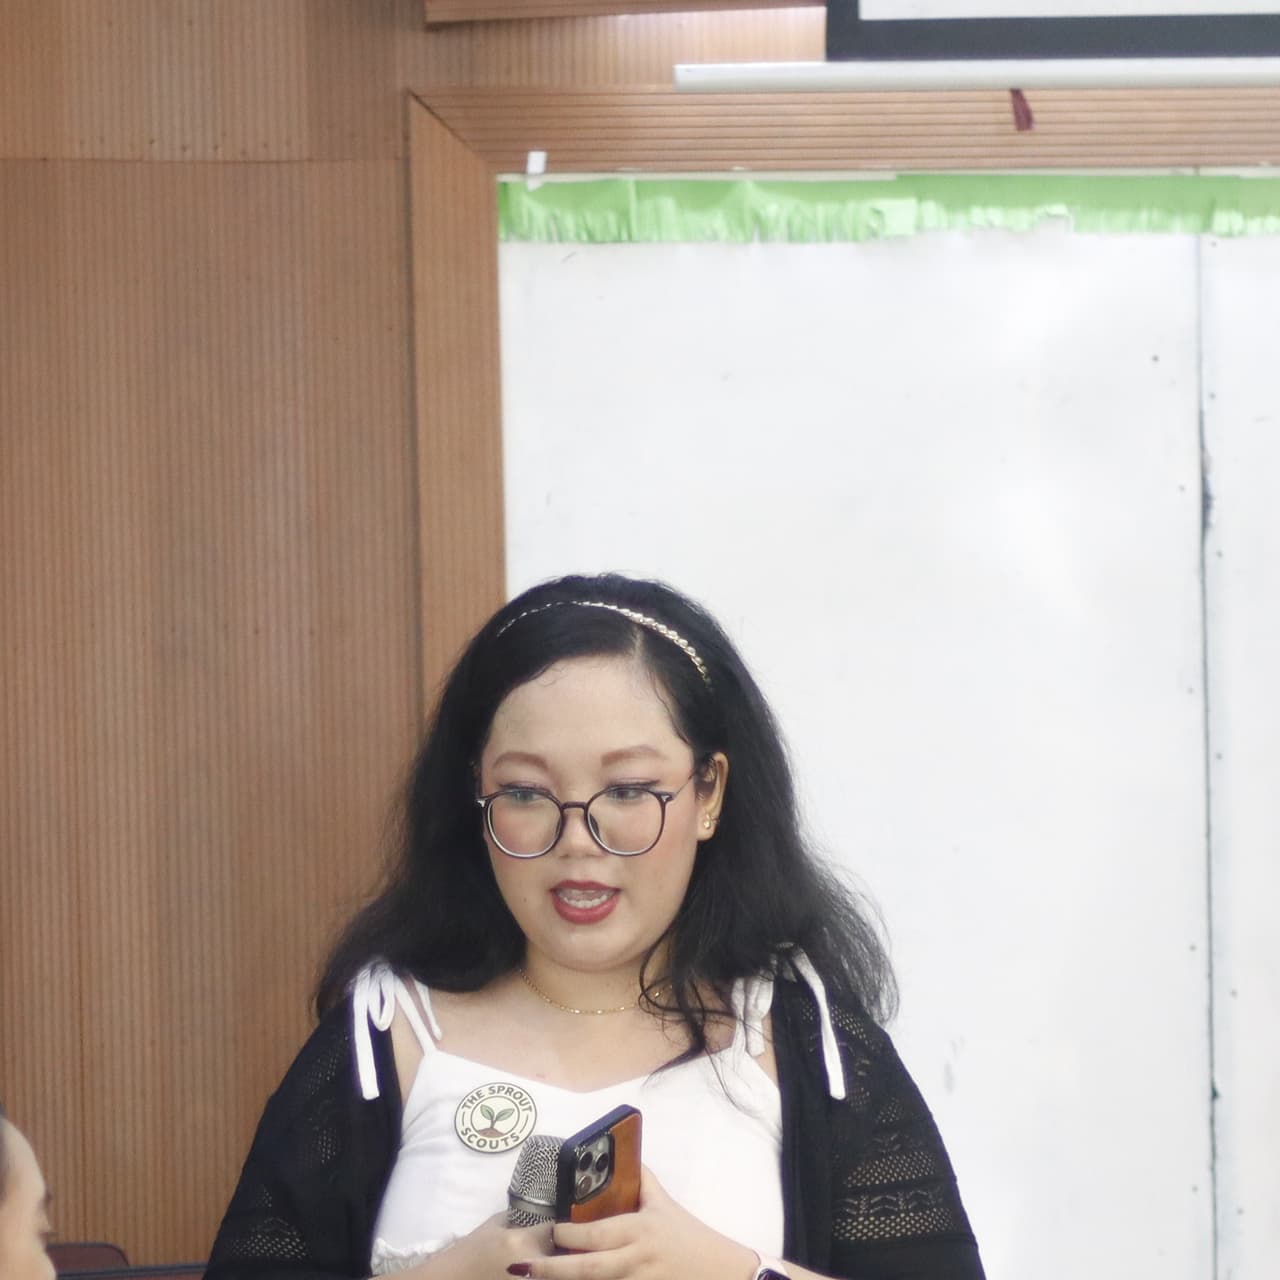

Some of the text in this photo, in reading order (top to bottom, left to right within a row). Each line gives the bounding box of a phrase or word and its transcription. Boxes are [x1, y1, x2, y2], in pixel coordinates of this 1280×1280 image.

[461, 1085, 532, 1112] THE SPROUT
[461, 1126, 520, 1150] SCOUTS
